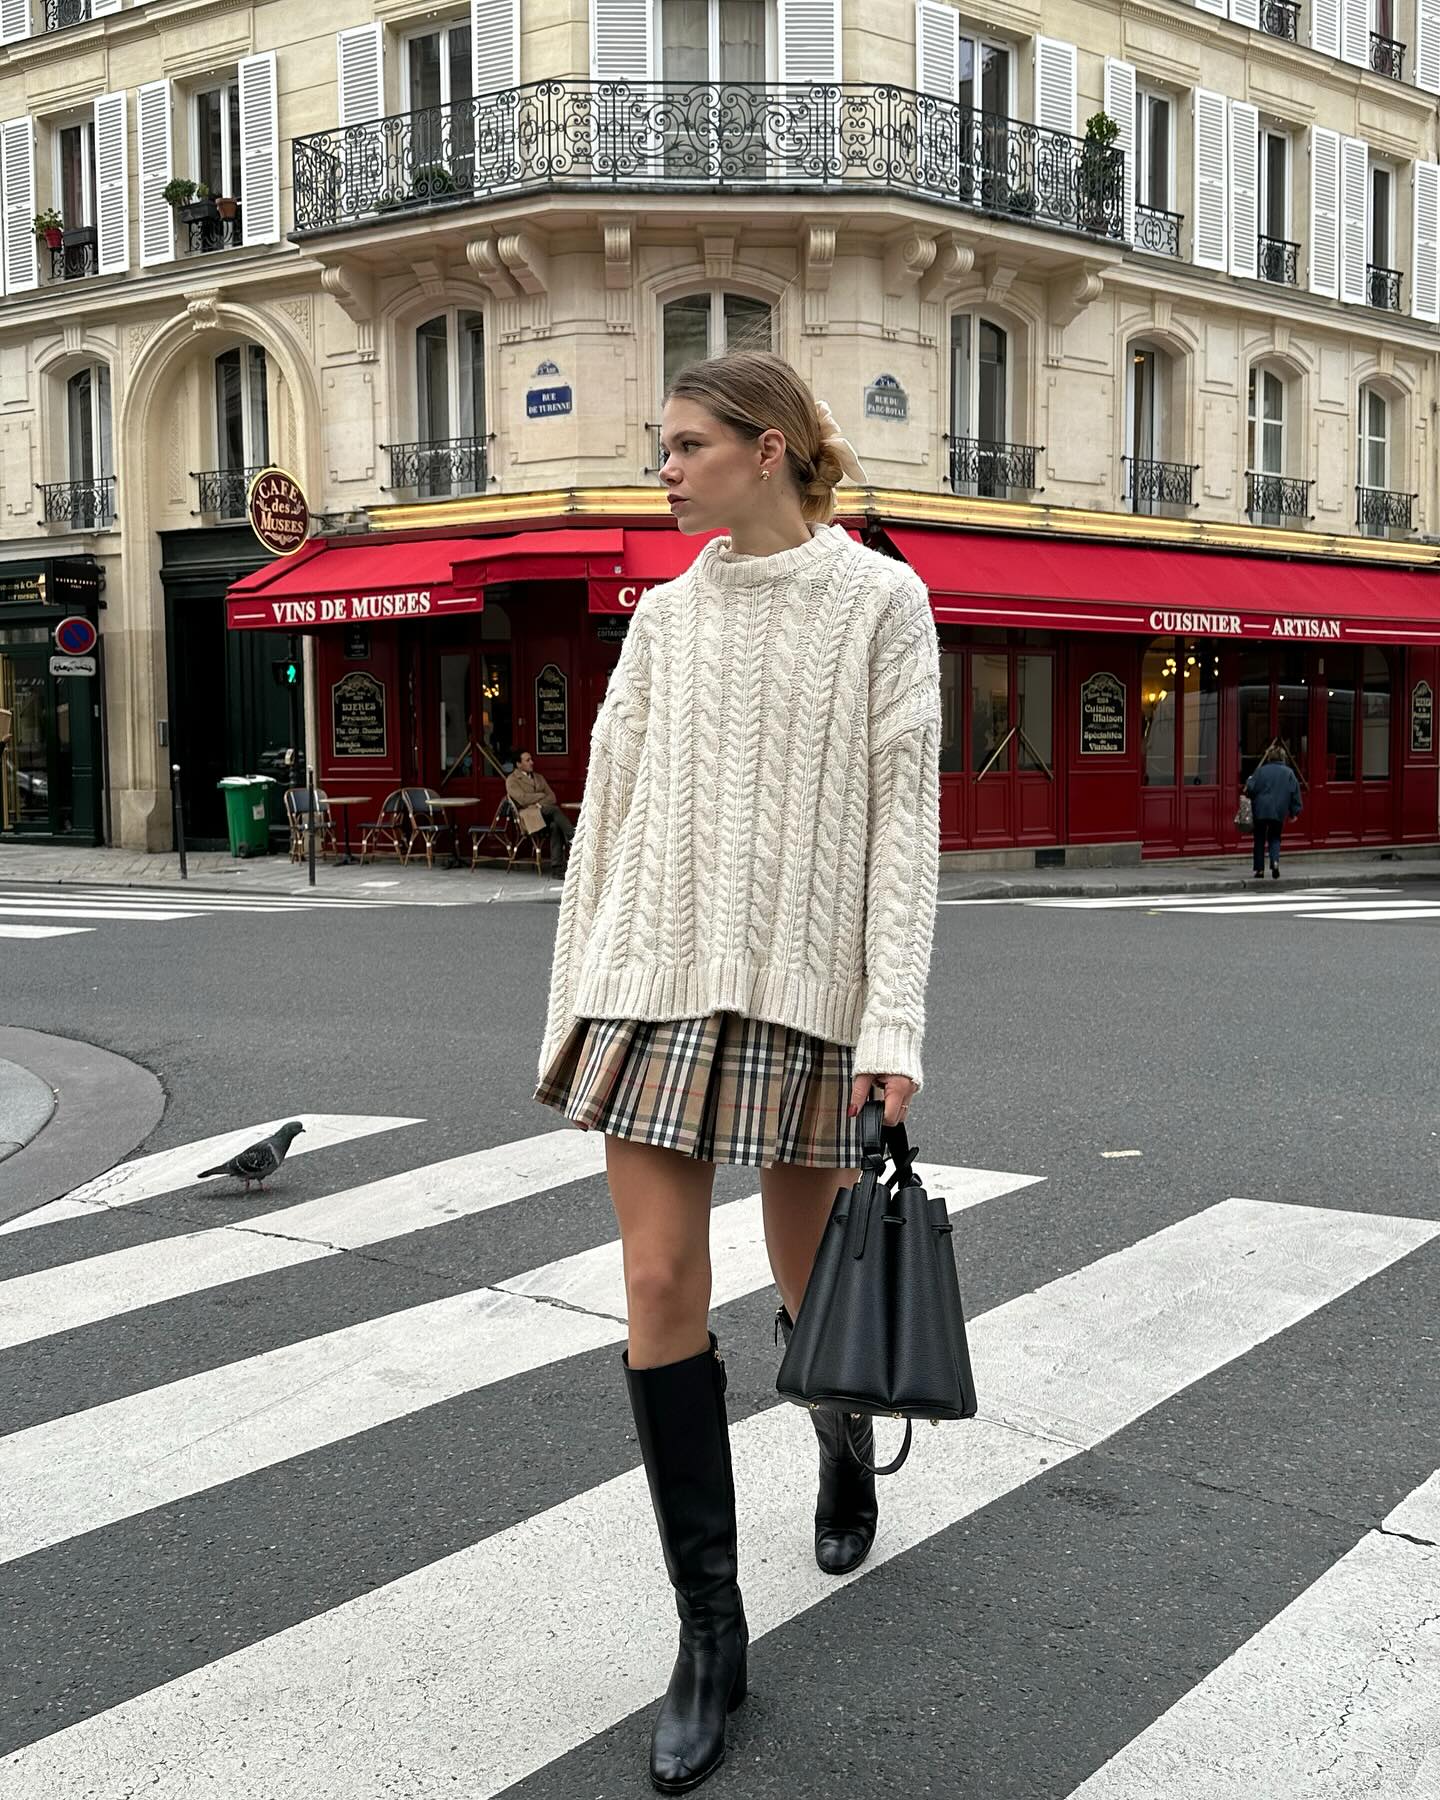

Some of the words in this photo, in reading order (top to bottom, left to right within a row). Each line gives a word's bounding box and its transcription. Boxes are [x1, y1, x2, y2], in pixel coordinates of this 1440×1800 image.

[541, 392, 557, 402] RUE
[874, 394, 889, 406] RUE
[889, 396, 898, 406] DU
[528, 405, 538, 415] DE
[539, 401, 571, 413] TURENNE
[271, 498, 291, 514] des
[272, 600, 316, 624] VINS
[320, 598, 347, 621] DE
[350, 591, 431, 618] MUSEES
[1150, 610, 1243, 634] CUISINIER
[1271, 617, 1342, 638] ARTISAN
[1084, 704, 1116, 713] Cuisine
[1092, 713, 1123, 723] Maison
